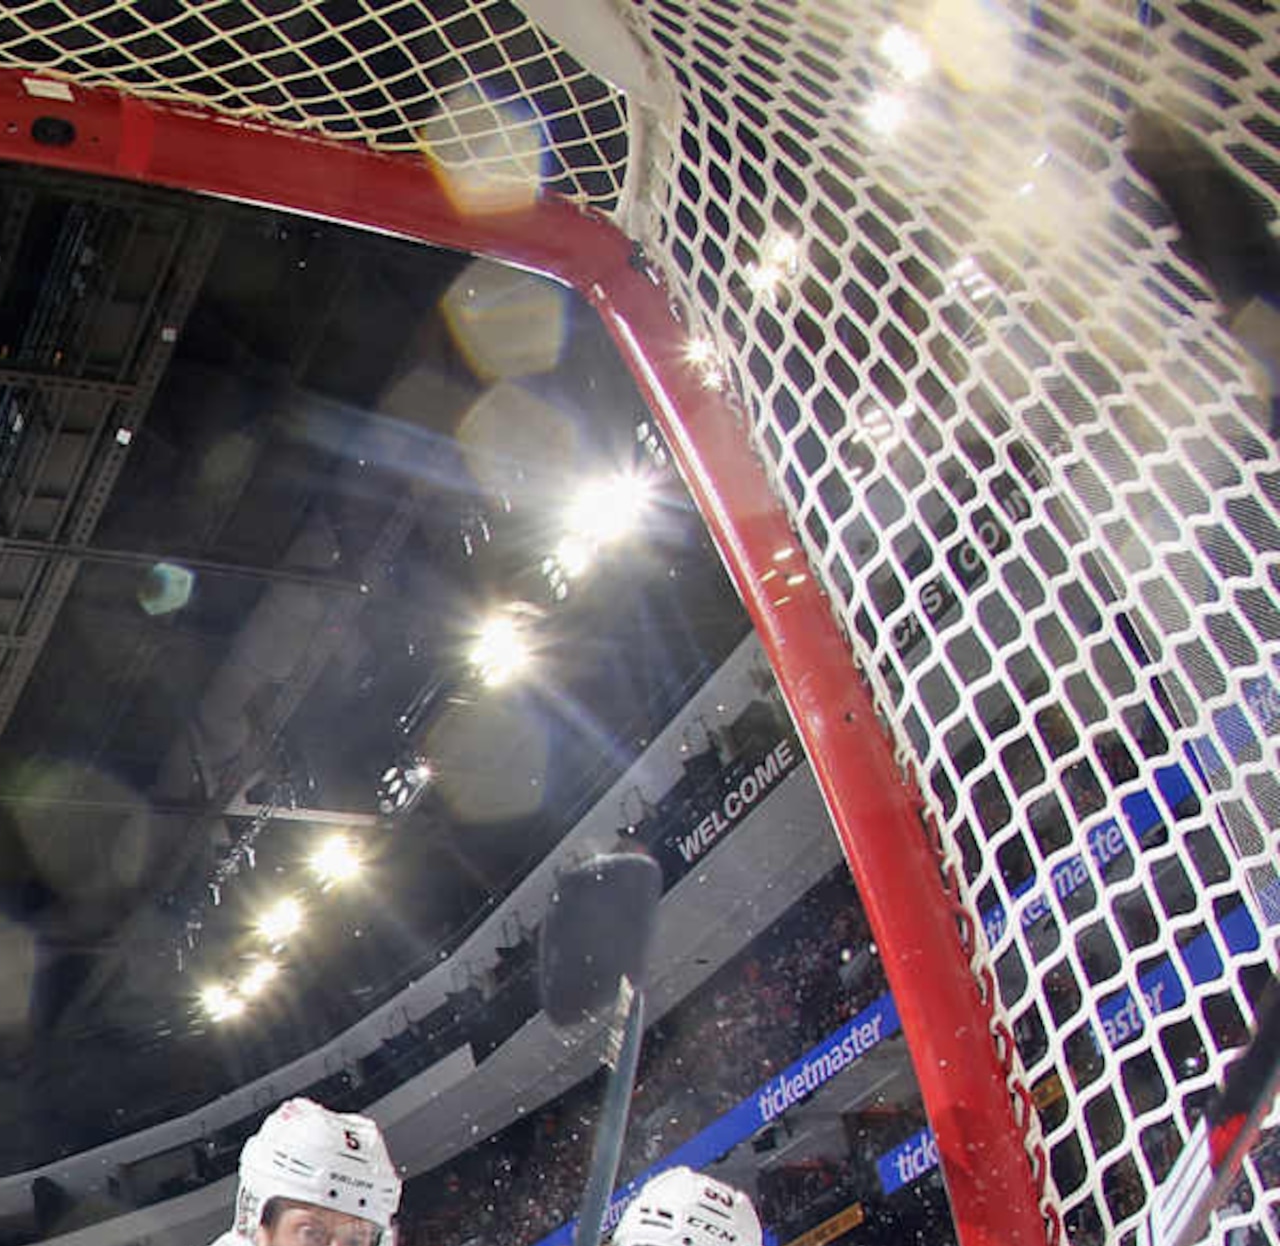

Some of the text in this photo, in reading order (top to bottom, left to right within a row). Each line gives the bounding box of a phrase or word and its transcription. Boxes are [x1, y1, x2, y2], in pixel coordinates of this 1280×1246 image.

[677, 738, 795, 863] WELCOME
[757, 1012, 883, 1121] ticketmaster
[343, 1129, 360, 1151] 5
[686, 1216, 737, 1244] CCM
